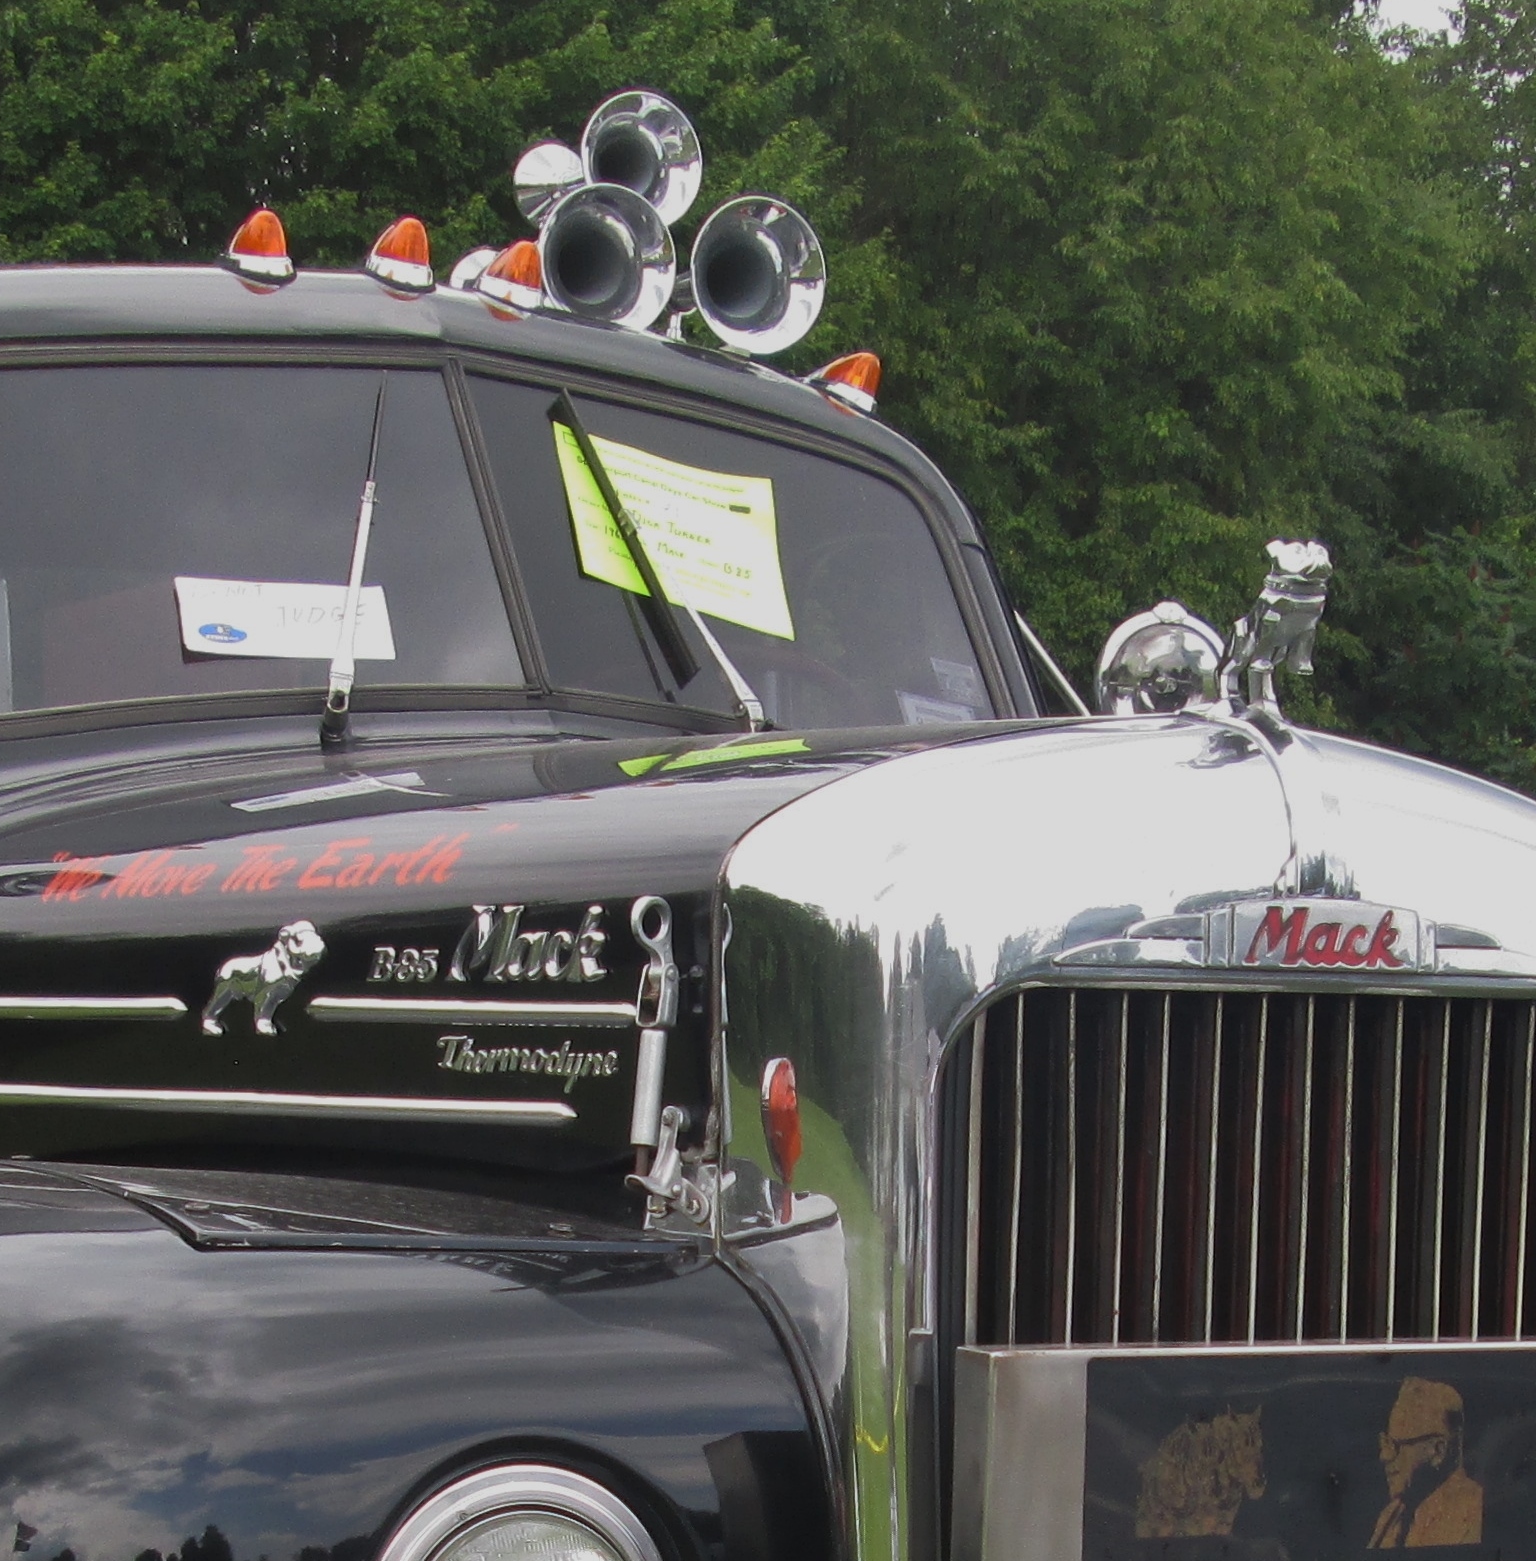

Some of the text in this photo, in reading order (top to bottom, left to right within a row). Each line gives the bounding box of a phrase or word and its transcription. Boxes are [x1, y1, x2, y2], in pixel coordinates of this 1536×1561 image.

[221, 844, 297, 893] The
[445, 904, 609, 982] Mack
[1242, 905, 1406, 969] Mack
[436, 1035, 619, 1093] Thermodyne
